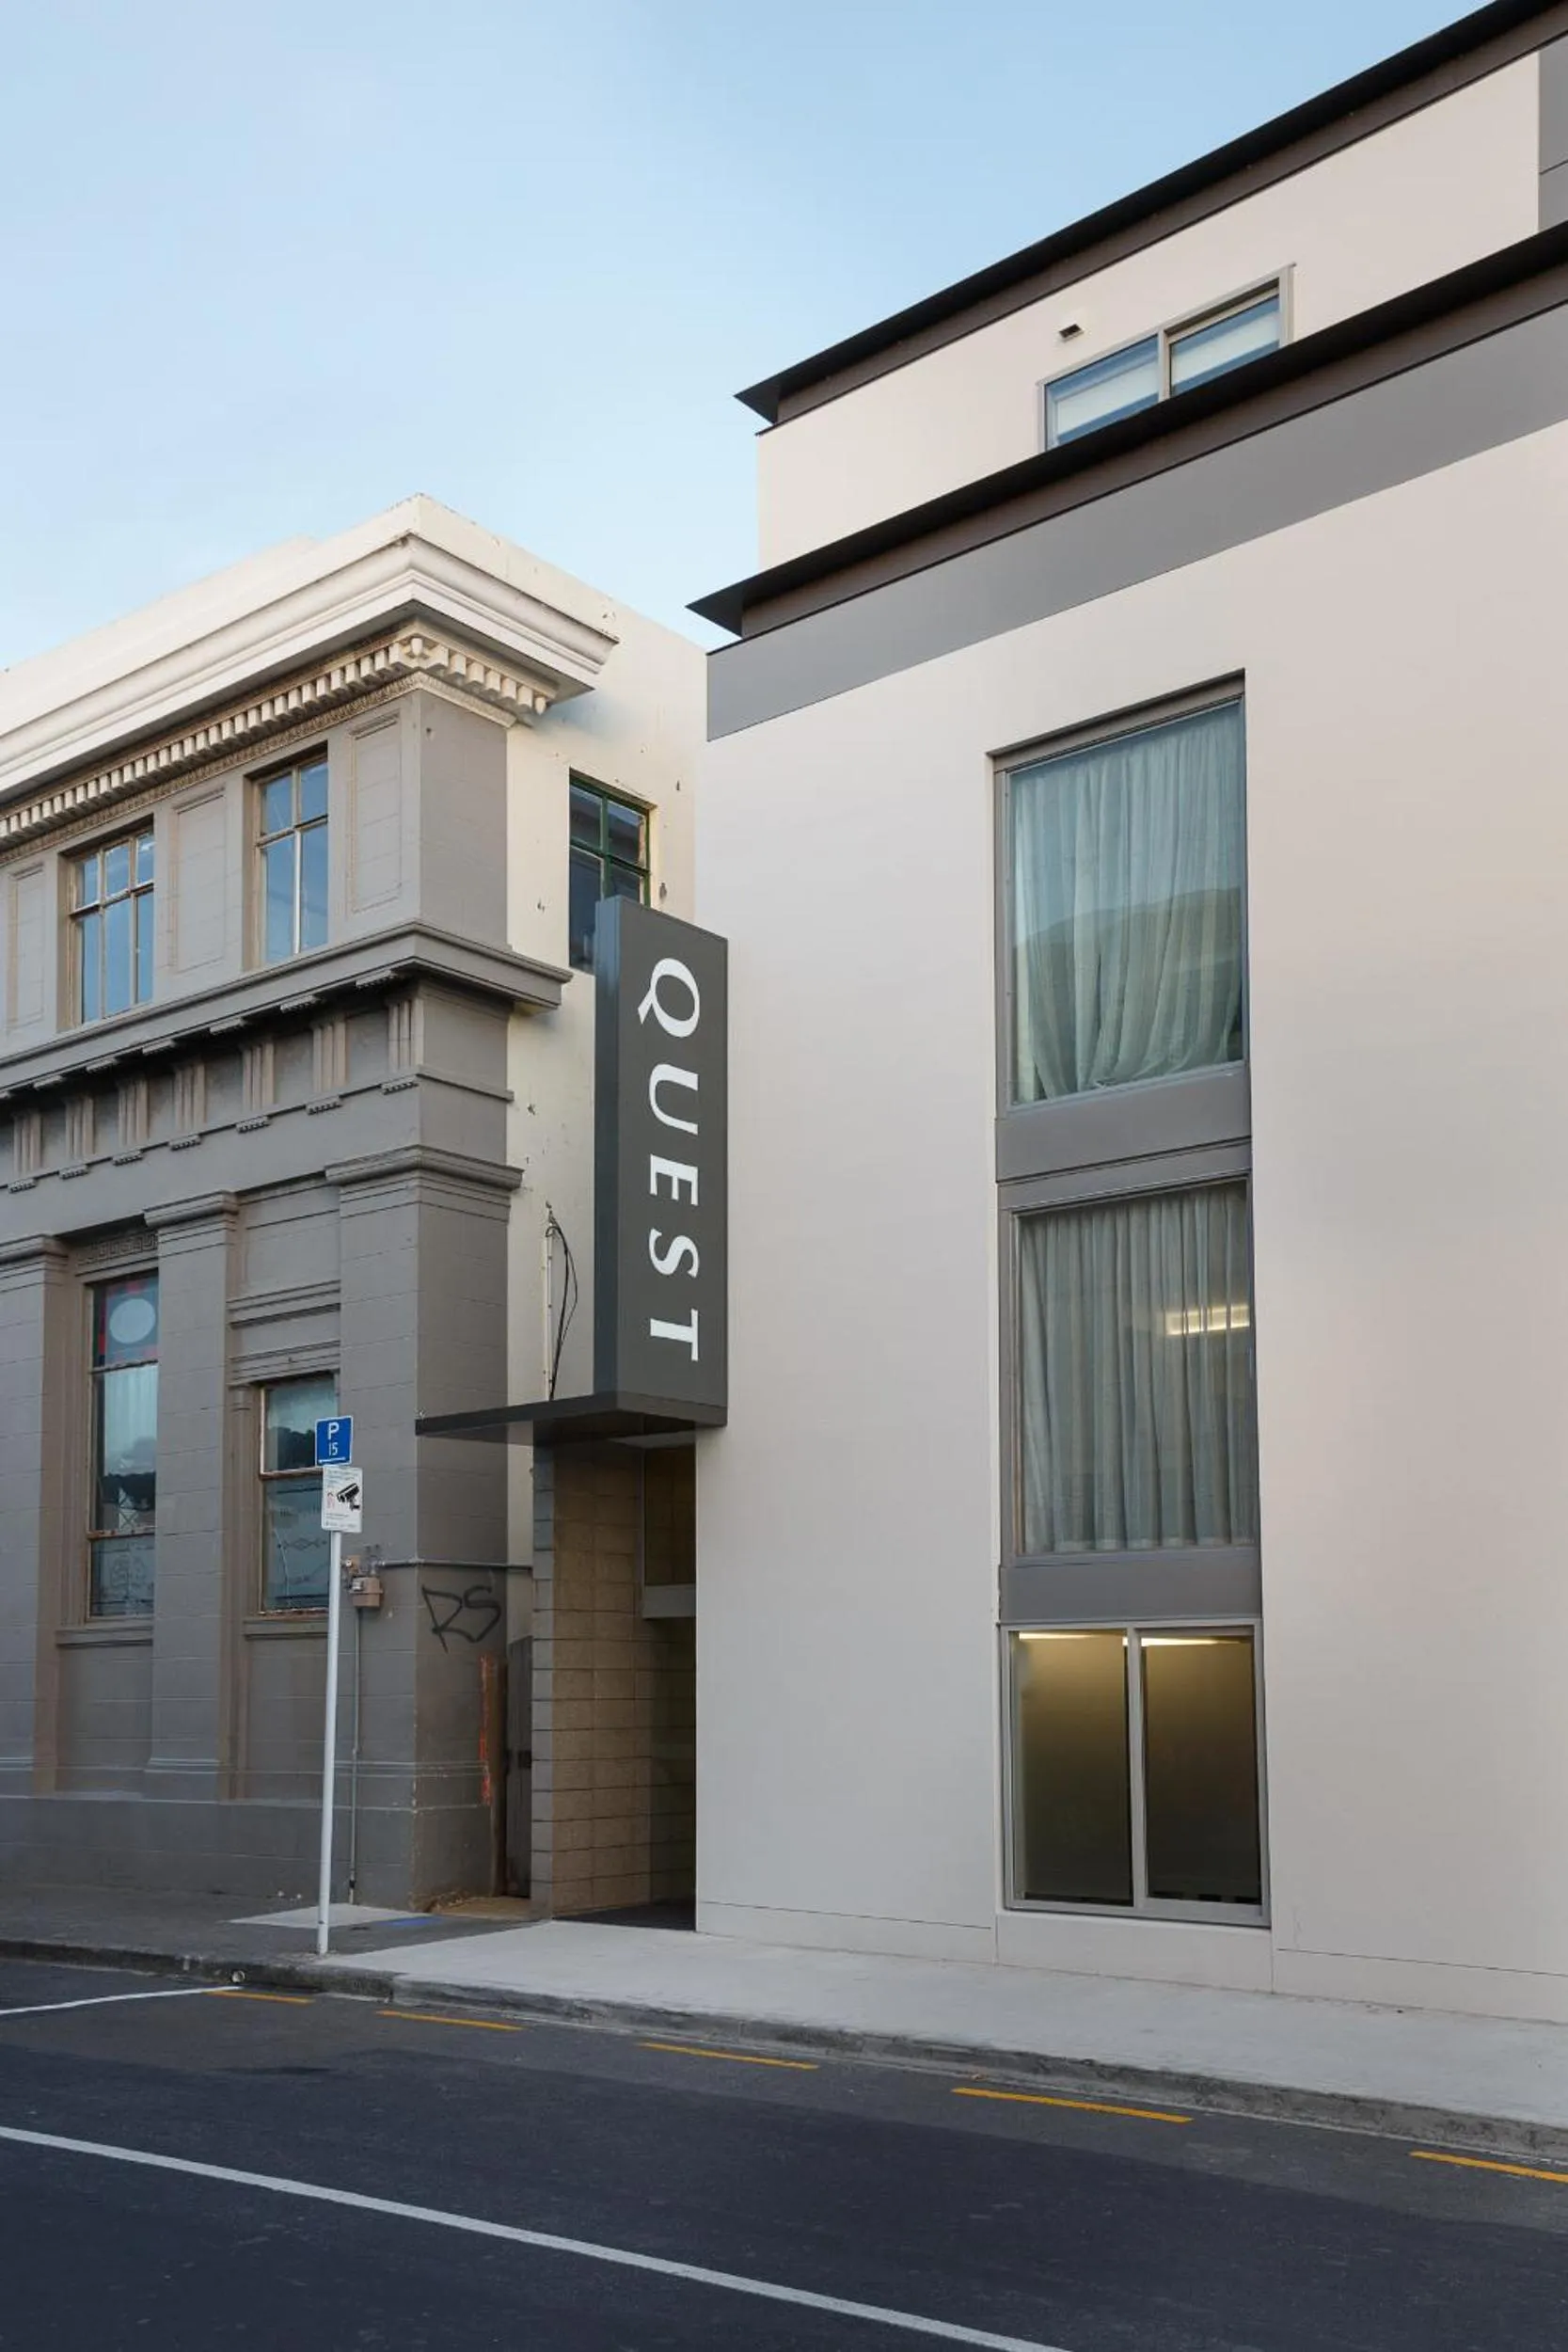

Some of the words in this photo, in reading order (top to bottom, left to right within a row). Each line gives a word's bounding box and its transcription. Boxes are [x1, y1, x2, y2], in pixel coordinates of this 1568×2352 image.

[638, 958, 701, 1361] QUEST
[327, 1422, 340, 1440] P
[328, 1442, 339, 1456] 15
